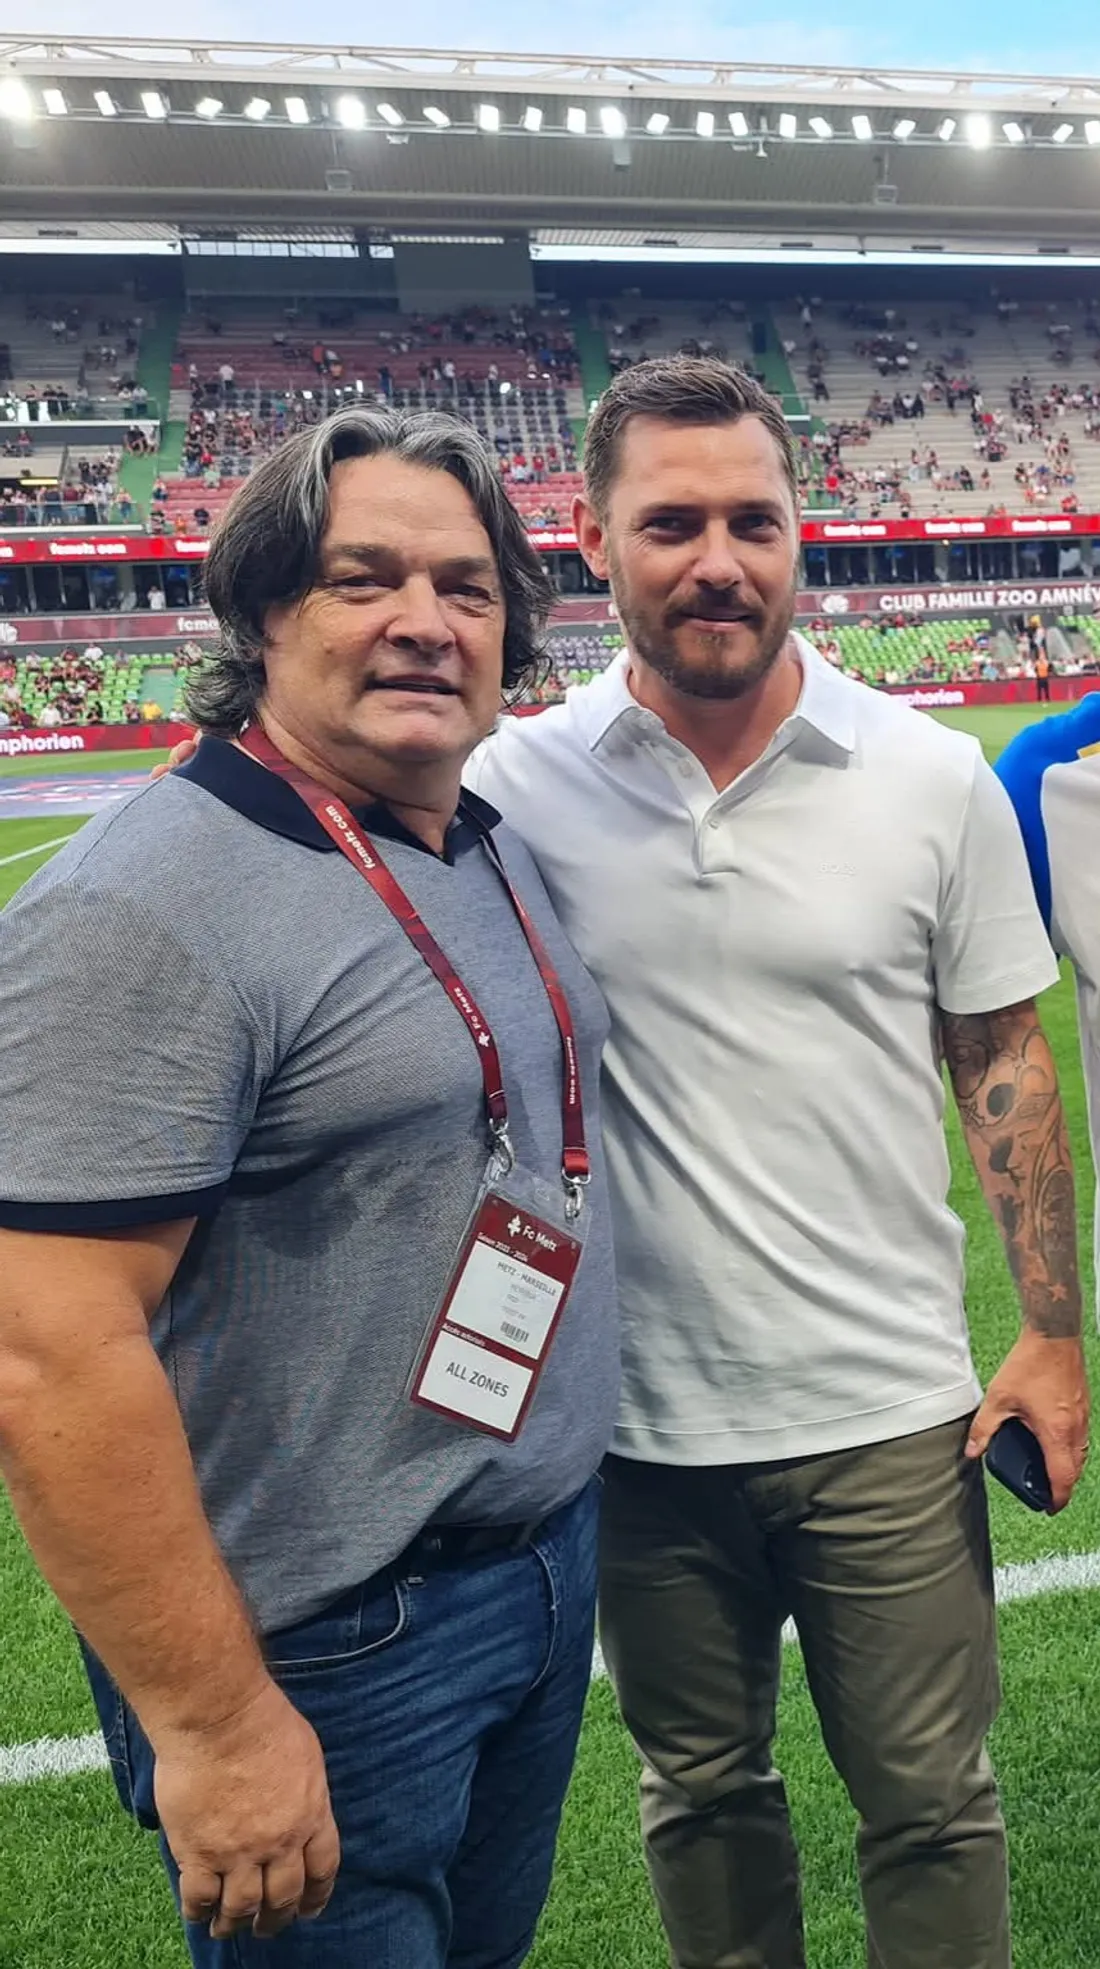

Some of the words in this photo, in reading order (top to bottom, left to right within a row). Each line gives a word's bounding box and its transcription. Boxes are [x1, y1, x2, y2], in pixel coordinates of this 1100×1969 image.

[879, 594, 926, 611] CLUB
[928, 591, 995, 609] FAMILLE
[997, 588, 1037, 606] ZOO
[535, 1232, 558, 1252] Metz
[497, 1261, 517, 1276] METZ
[520, 1273, 557, 1297] MARSEILLE
[446, 1361, 467, 1381] ALL
[468, 1370, 509, 1398] ZONES
